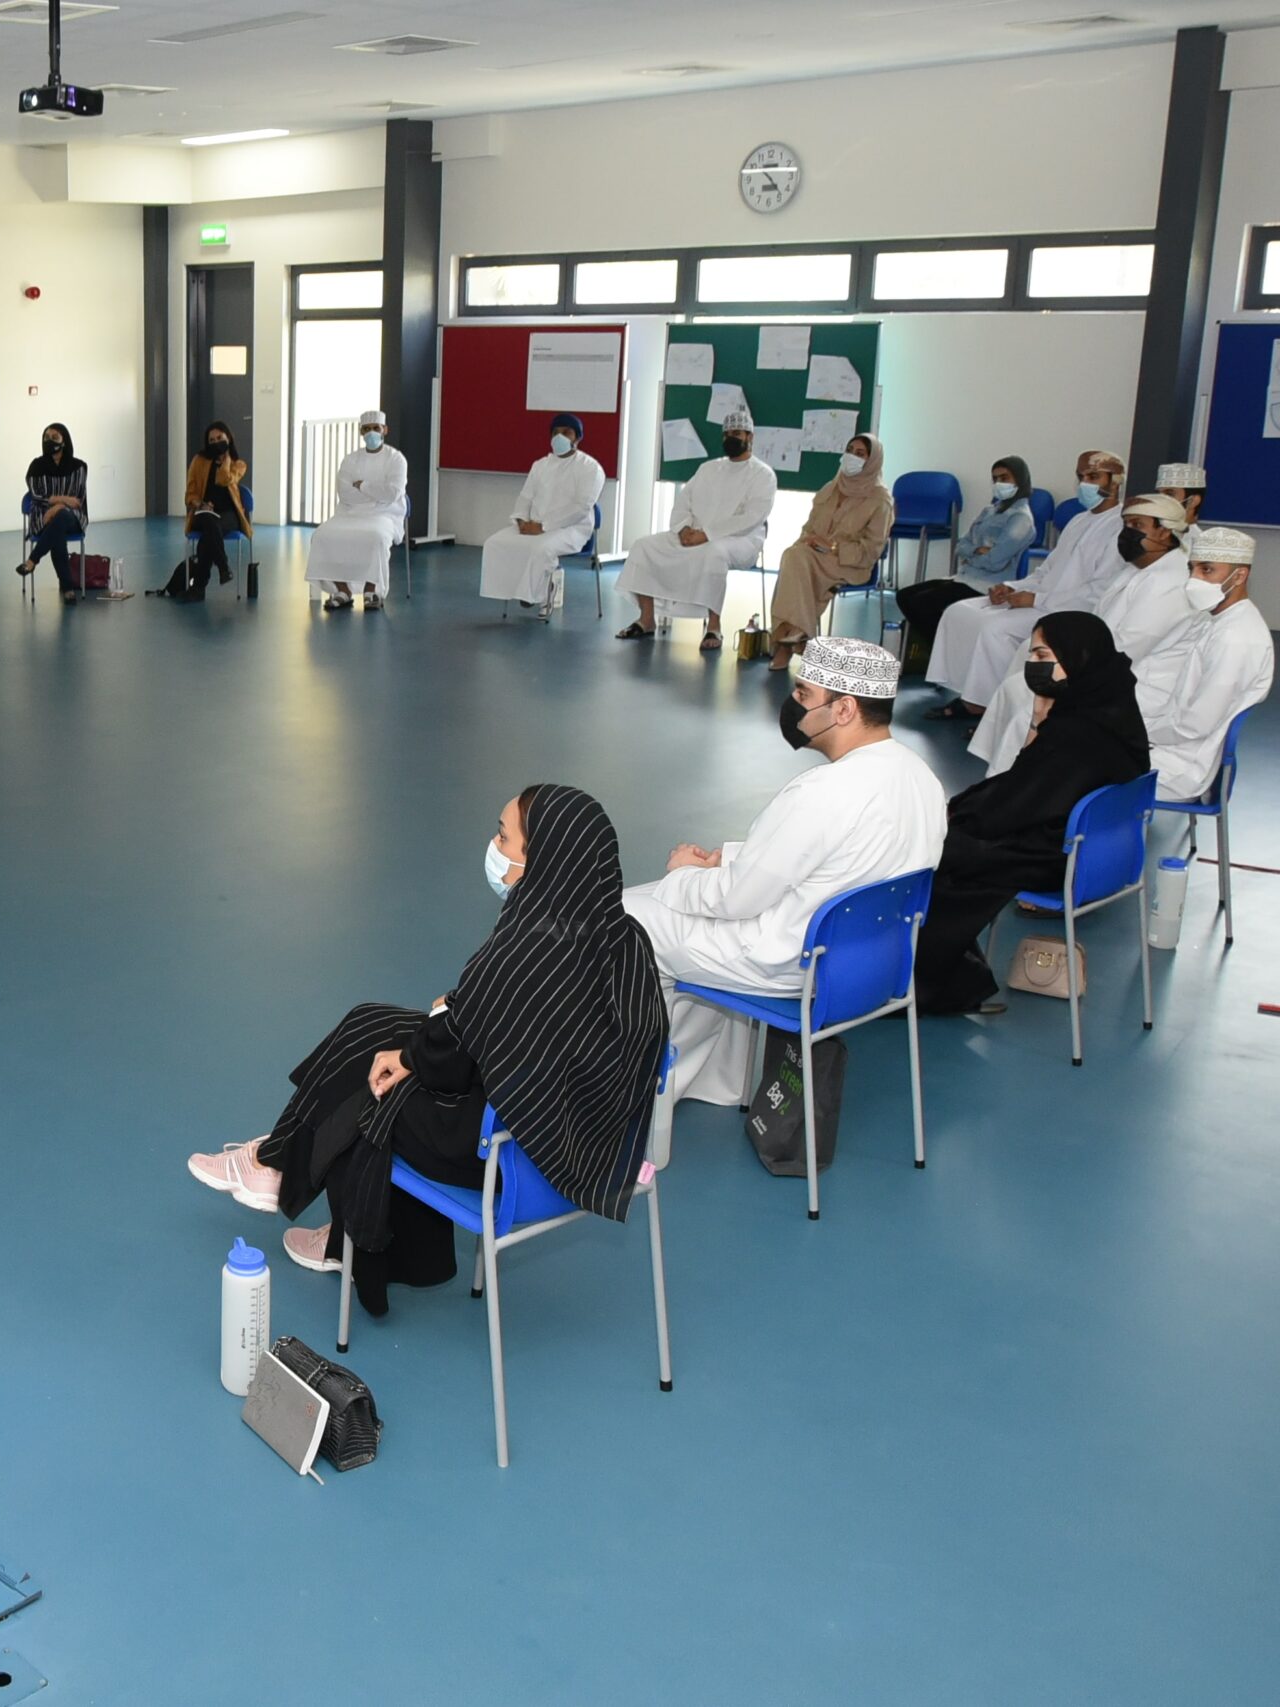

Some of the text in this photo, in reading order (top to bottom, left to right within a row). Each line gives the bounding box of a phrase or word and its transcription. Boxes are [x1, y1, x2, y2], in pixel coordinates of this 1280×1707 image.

[758, 154, 764, 162] 11
[767, 149, 776, 159] 12
[746, 175, 752, 184] 9
[788, 172, 794, 181] 3
[750, 187, 754, 196] 8
[785, 184, 790, 192] 4
[756, 195, 762, 204] 7
[766, 198, 772, 207] 6
[766, 1081, 784, 1110] Bag
